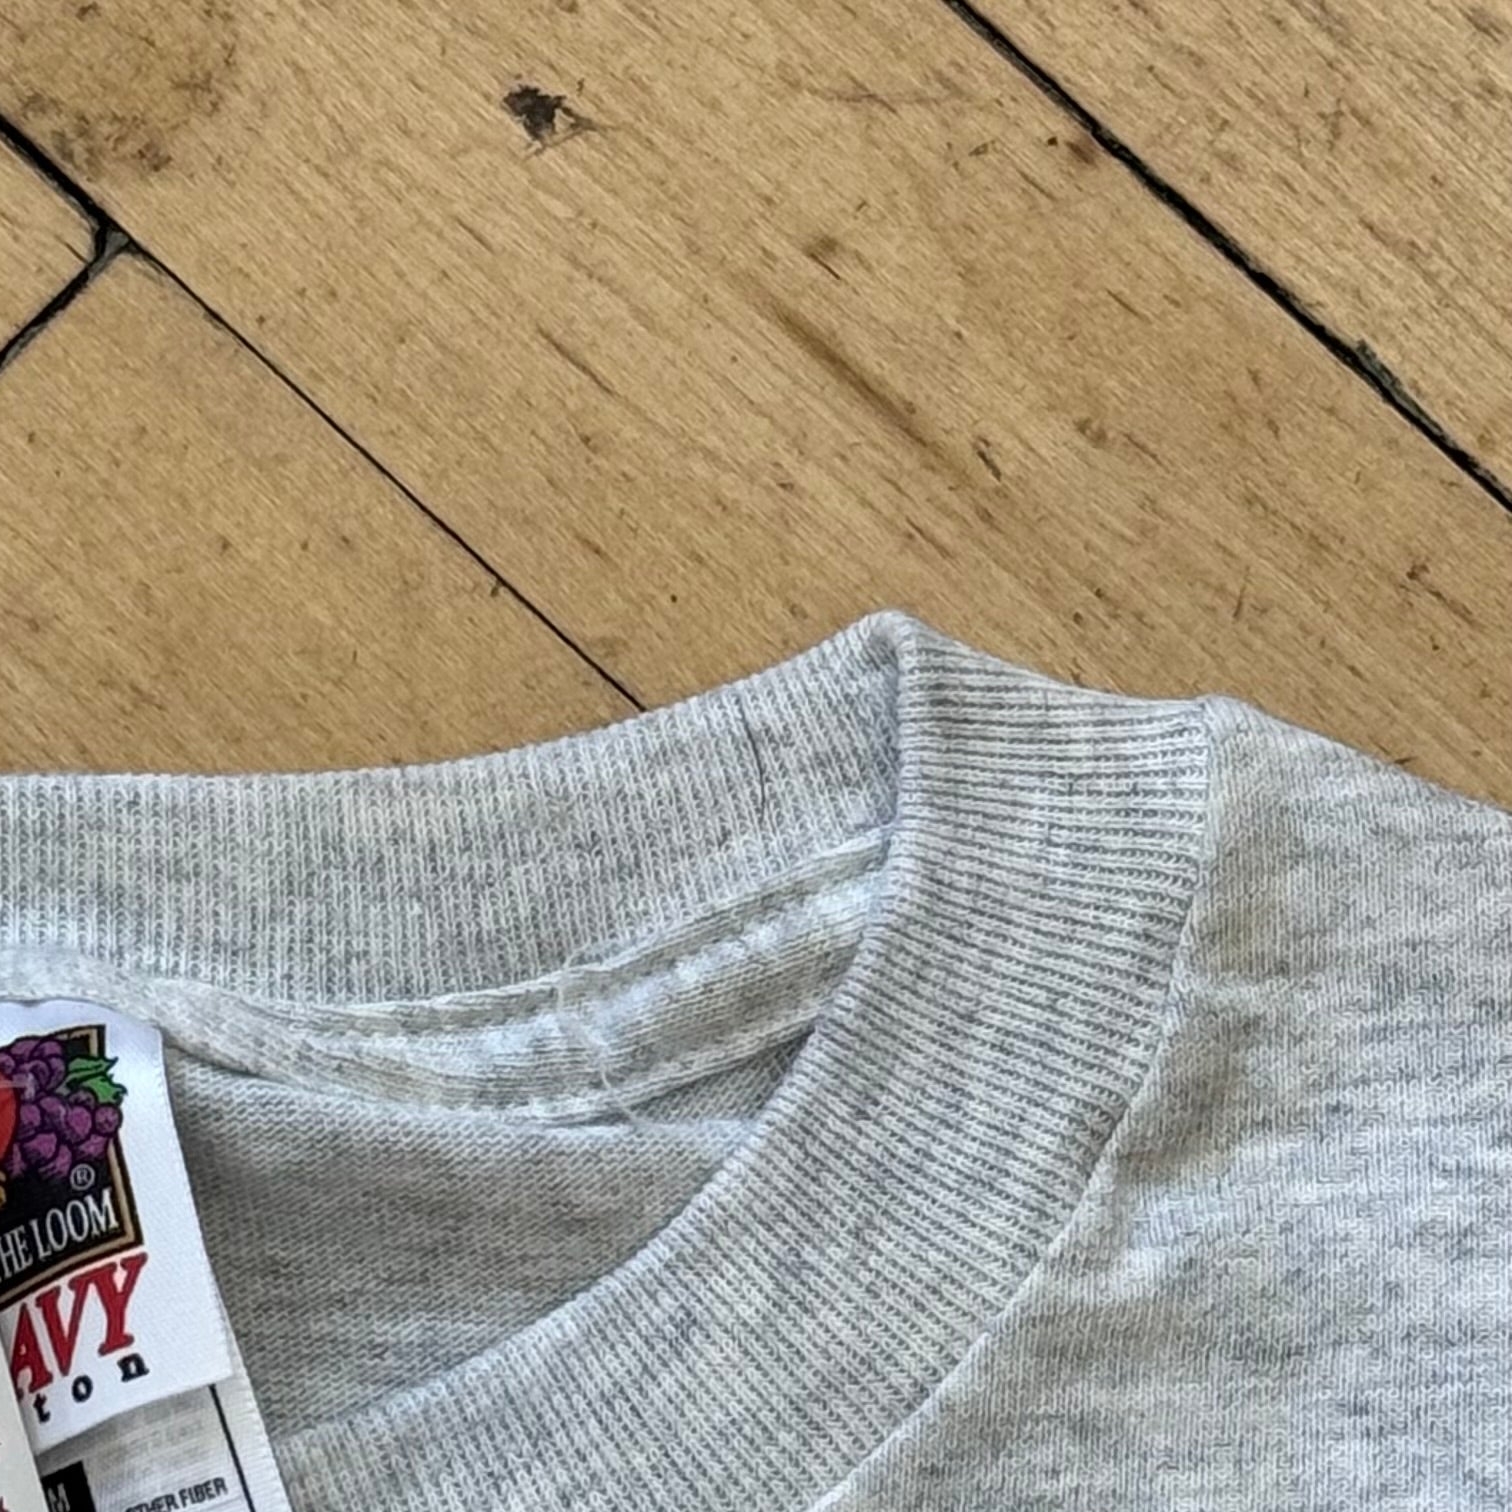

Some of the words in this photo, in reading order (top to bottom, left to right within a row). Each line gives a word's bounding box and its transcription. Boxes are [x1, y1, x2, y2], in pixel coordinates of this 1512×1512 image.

[30, 1186, 120, 1262] LOOM
[10, 1251, 149, 1399] AVY
[33, 1352, 150, 1424] ton
[178, 1477, 229, 1508] FIBER
